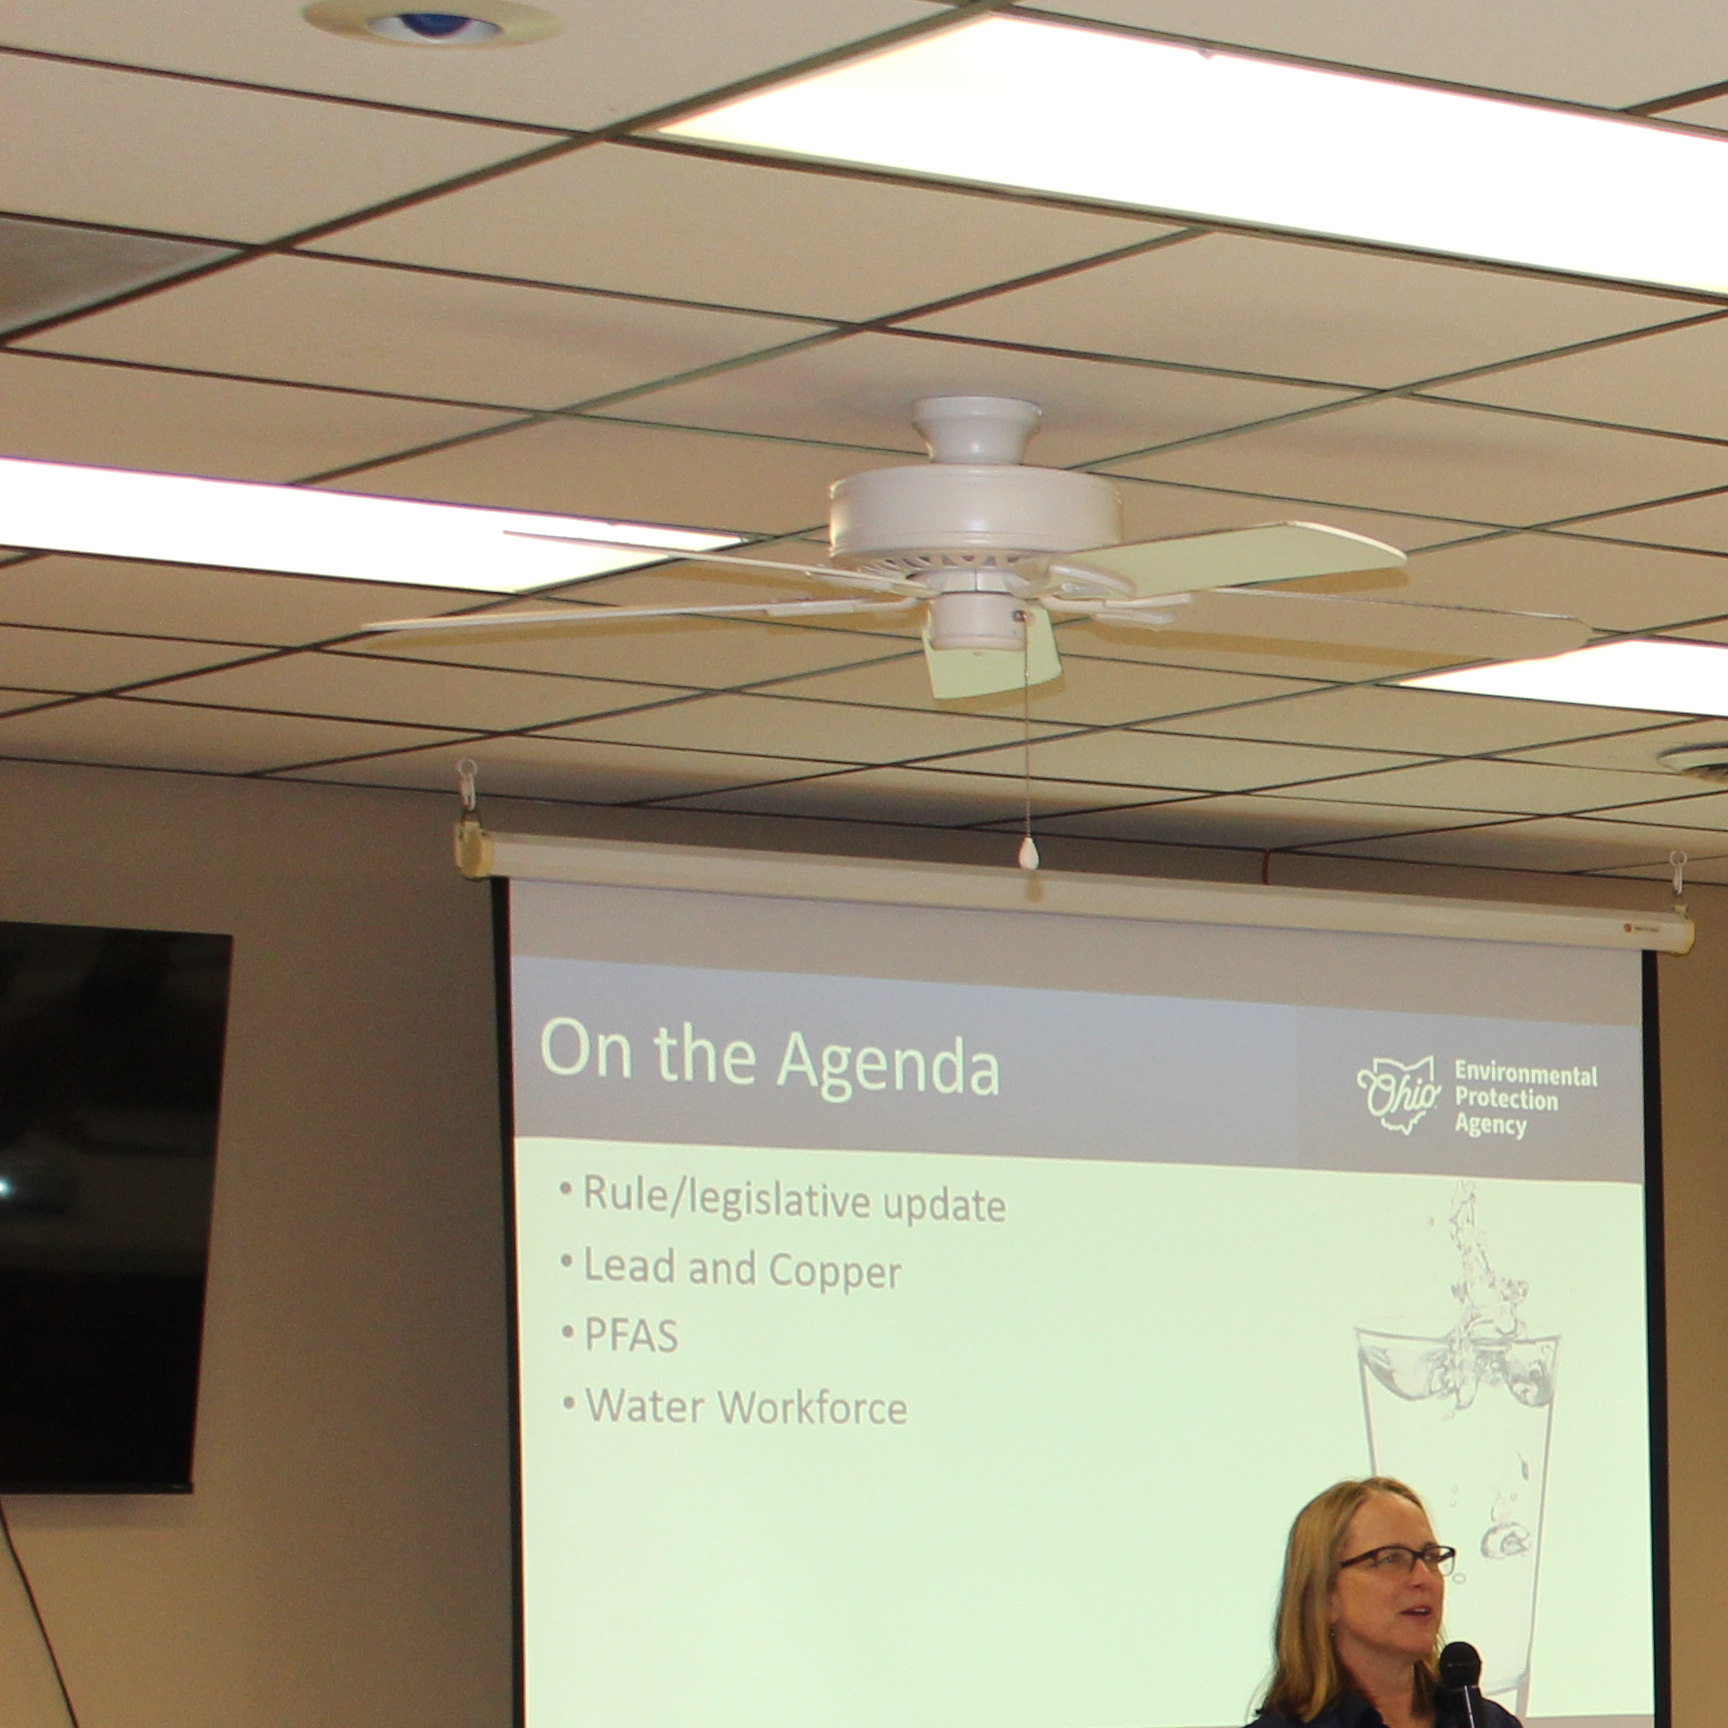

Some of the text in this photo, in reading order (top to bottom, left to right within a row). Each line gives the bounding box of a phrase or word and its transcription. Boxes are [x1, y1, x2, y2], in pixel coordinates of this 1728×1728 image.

[540, 1016, 1002, 1103] On the Agenda
[1455, 1059, 1598, 1087] Environmental
[1357, 1069, 1442, 1117] Ohio
[1456, 1086, 1559, 1111] Protection
[1455, 1112, 1527, 1140] Agency
[583, 1174, 1008, 1227] Rule/legislative update
[583, 1246, 903, 1293] Lead and Copper
[584, 1316, 680, 1356] PFAS
[584, 1387, 909, 1428] Water Workforce
